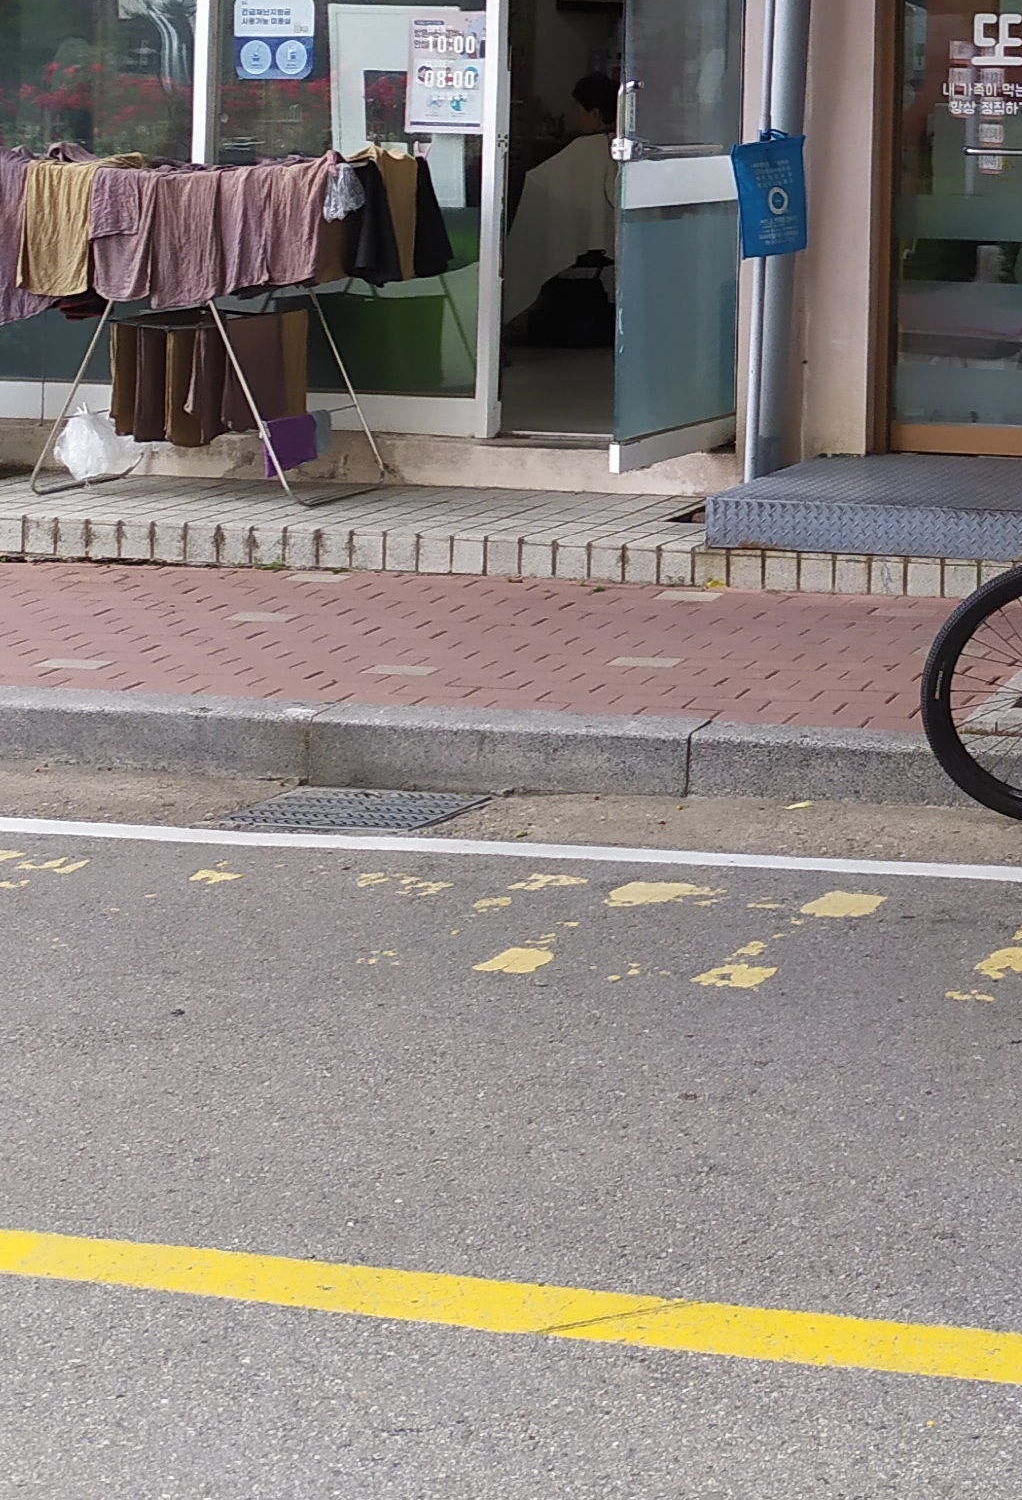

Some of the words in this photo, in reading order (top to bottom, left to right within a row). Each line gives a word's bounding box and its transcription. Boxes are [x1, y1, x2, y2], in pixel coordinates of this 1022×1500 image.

[427, 35, 475, 54] 10:00
[424, 70, 475, 88] 08:00
[942, 83, 955, 97] 내
[962, 83, 997, 97] 가족이
[950, 101, 976, 115] 항상
